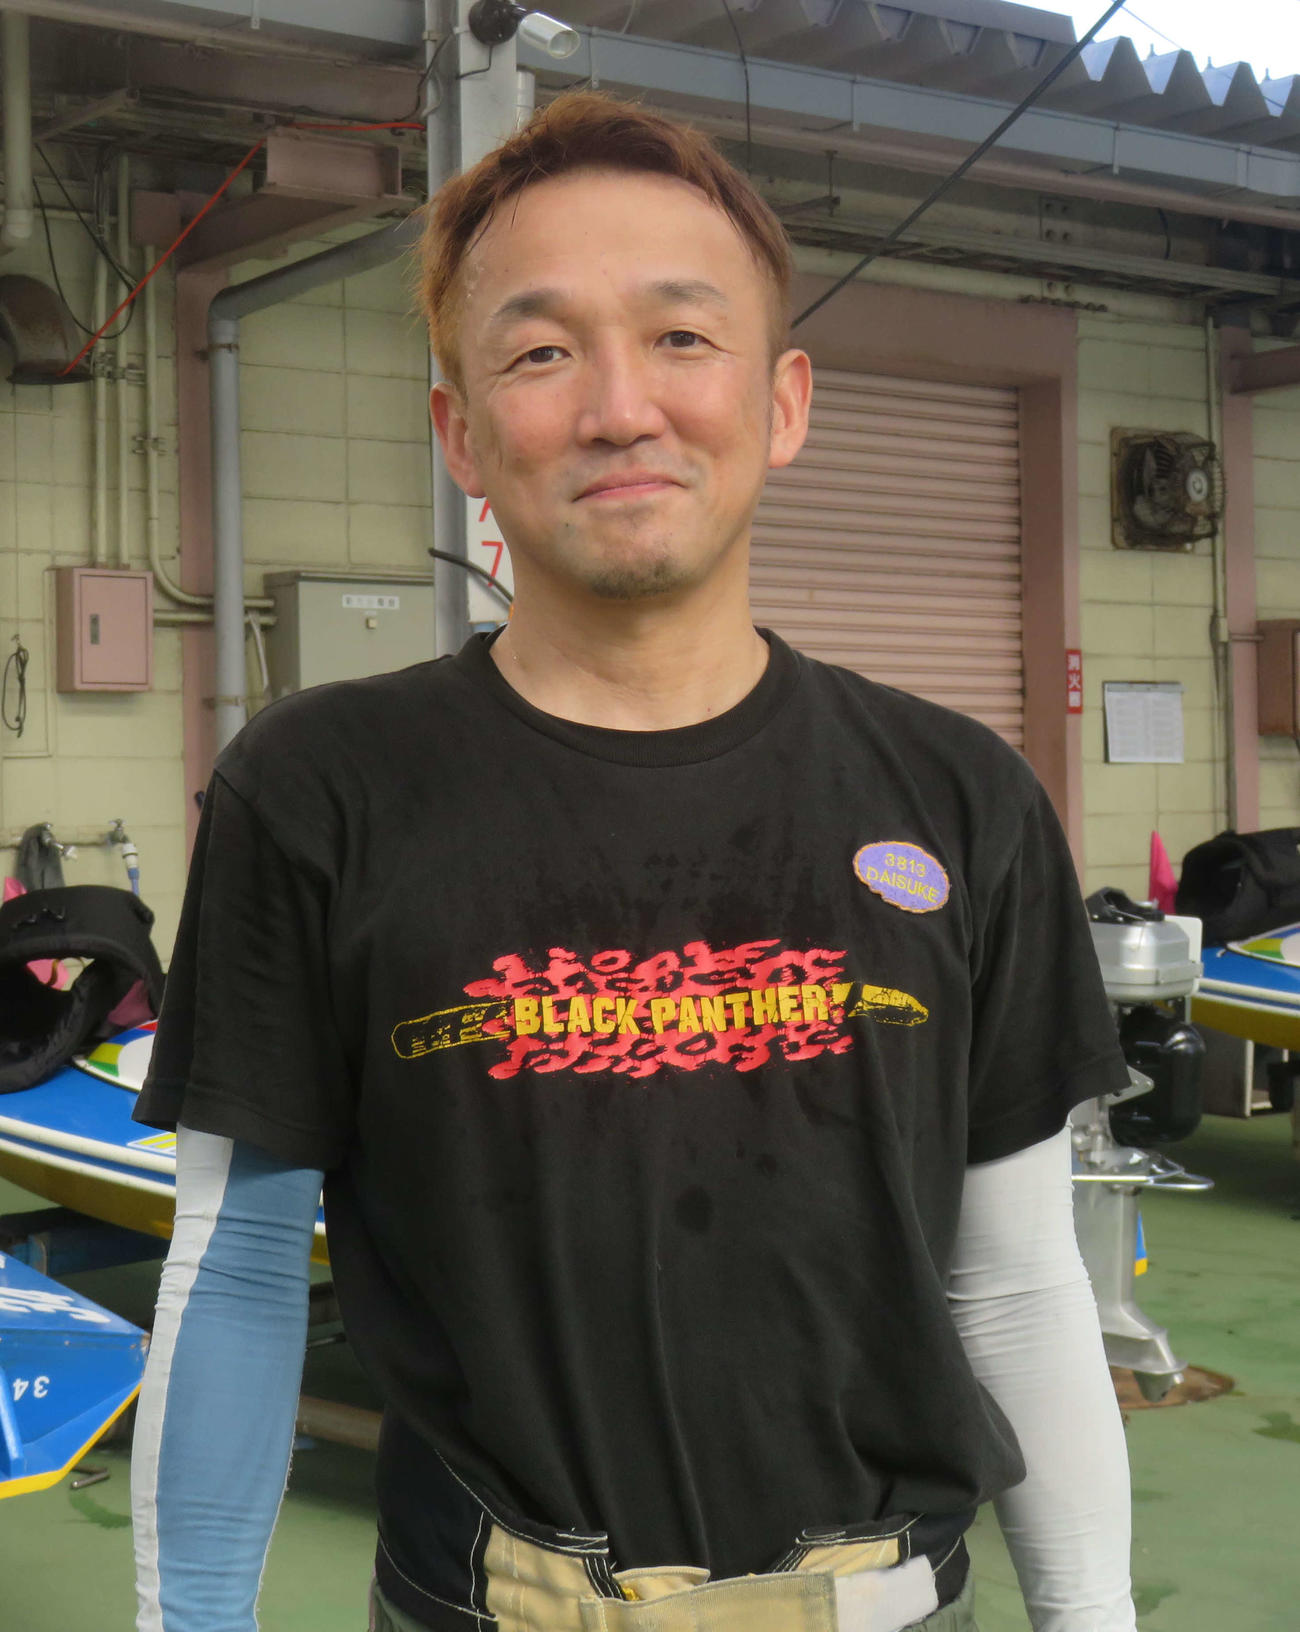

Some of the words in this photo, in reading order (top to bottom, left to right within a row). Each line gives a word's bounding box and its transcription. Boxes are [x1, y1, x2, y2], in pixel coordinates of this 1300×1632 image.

[884, 853, 926, 877] 3813
[866, 866, 939, 903] DAISUKE
[514, 996, 640, 1035] BLACK
[13, 1376, 50, 1401] 34
